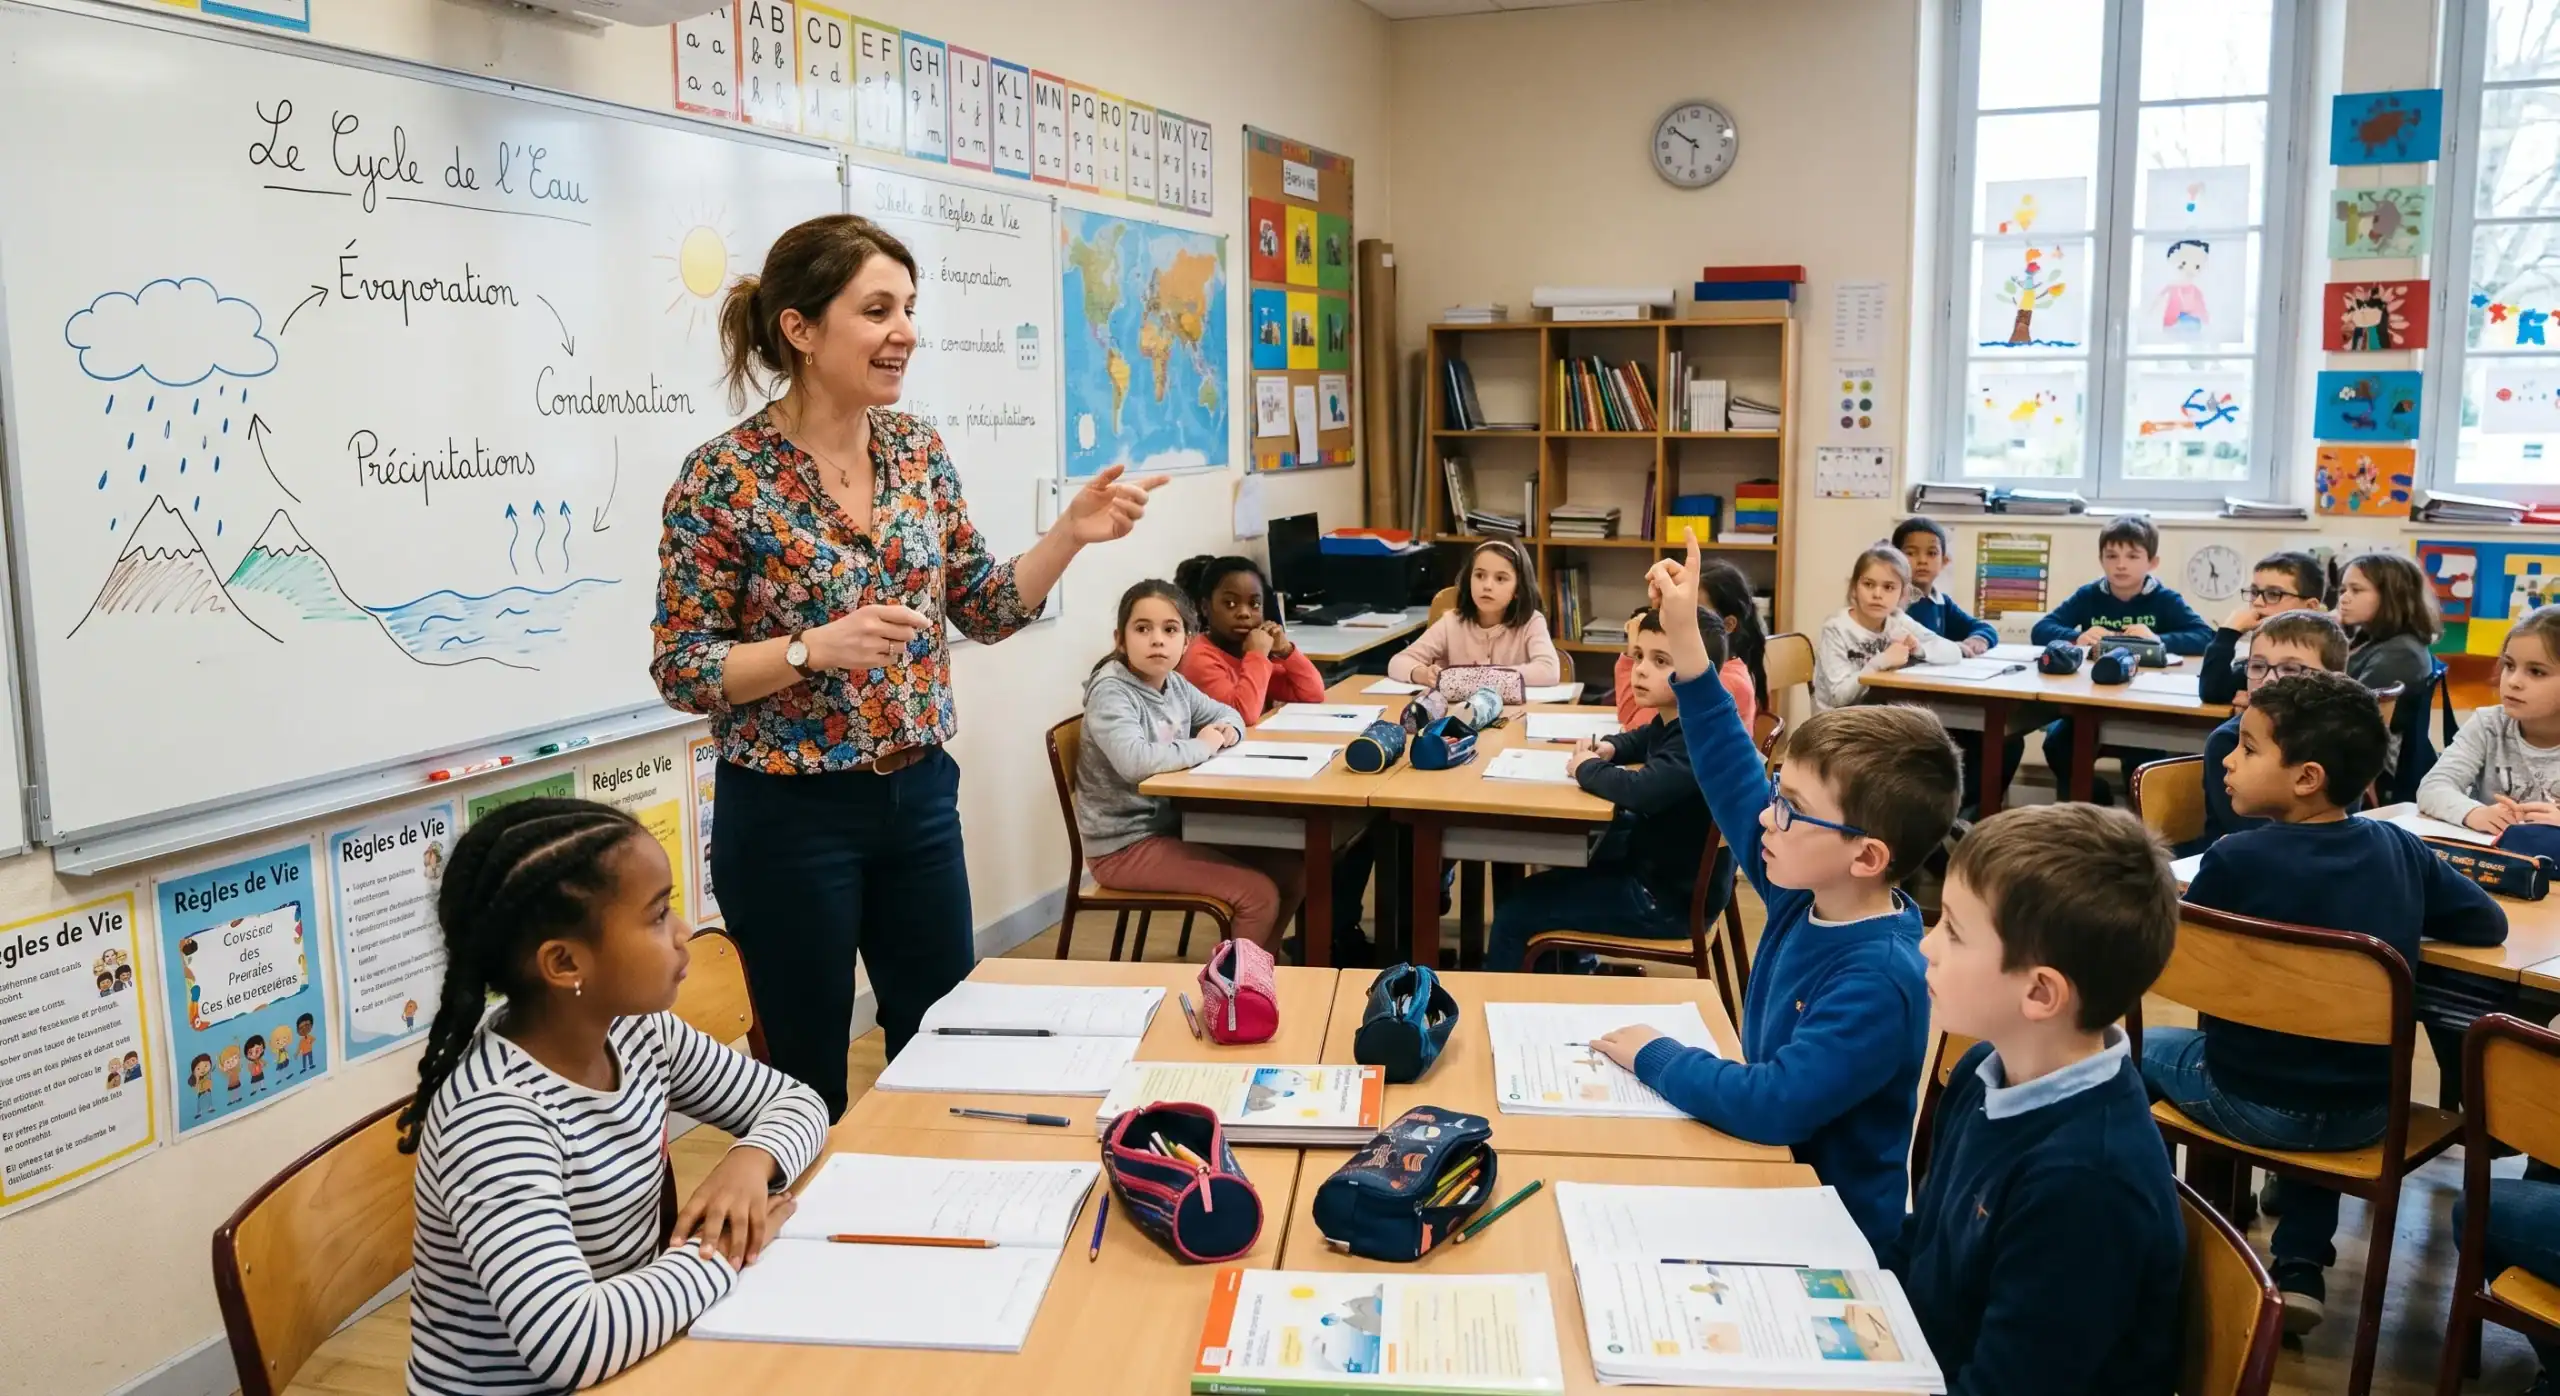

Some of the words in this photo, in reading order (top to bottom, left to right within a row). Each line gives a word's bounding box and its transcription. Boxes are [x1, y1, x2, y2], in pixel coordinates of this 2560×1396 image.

[249, 99, 306, 172] Le
[331, 109, 425, 213] Cycle
[444, 145, 481, 190] de
[494, 141, 589, 204] l'Eau
[939, 193, 976, 231] Règles
[980, 203, 994, 227] de
[1000, 202, 1020, 229] Vie
[339, 237, 519, 327] Évaporation
[941, 256, 1012, 296] évaporation
[536, 365, 696, 416] Condensation
[348, 429, 536, 507] Précipitations
[636, 760, 651, 779] de
[653, 755, 672, 774] Vie
[342, 837, 396, 863] Règles
[399, 825, 417, 847] de
[421, 817, 445, 839] Vie
[174, 881, 239, 914] Règles
[244, 870, 266, 893] de
[270, 862, 299, 885] Vie
[0, 934, 50, 969] gles
[56, 921, 83, 947] de
[88, 911, 123, 936] Vie
[239, 948, 260, 963] des
